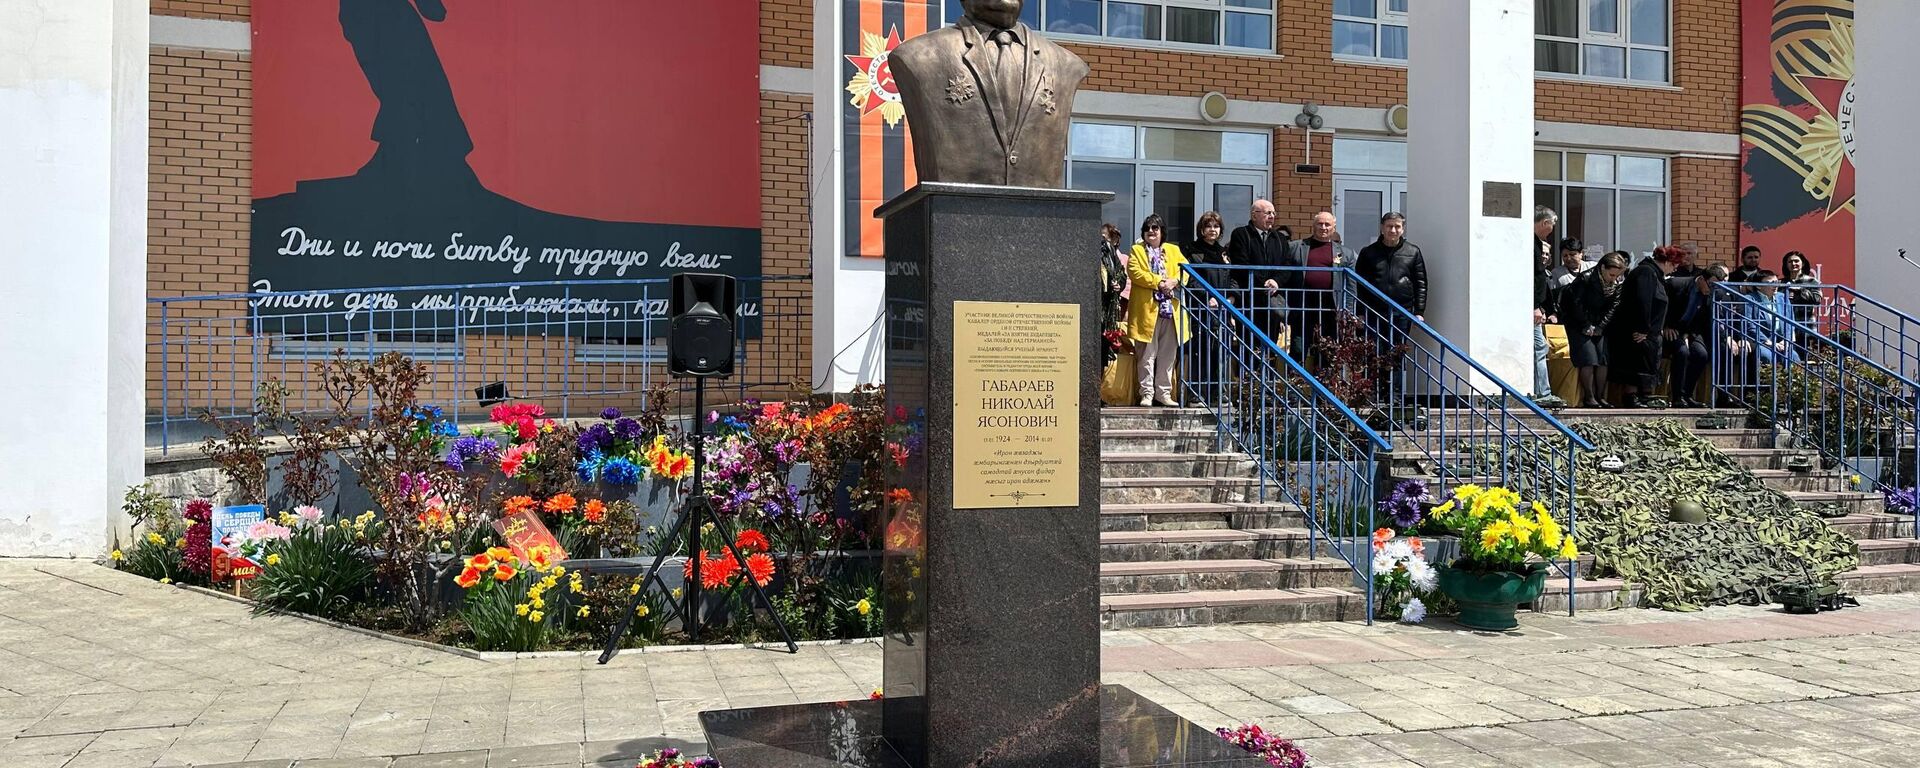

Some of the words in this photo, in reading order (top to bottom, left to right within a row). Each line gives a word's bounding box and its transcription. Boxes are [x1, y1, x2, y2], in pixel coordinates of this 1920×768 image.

[278, 227, 335, 256] Дни
[343, 240, 363, 257] и
[372, 240, 436, 259] ночи
[444, 232, 531, 274] битву
[539, 247, 648, 277] трудную
[249, 279, 334, 309] Этот
[343, 292, 399, 321] день
[411, 294, 456, 310] мы
[458, 285, 620, 324] приближали,
[981, 380, 1054, 392] ГАБАРАЕВ
[981, 394, 1054, 410] НИКОЛАЙ
[977, 415, 1058, 428] ЯСОНОВИЧ
[995, 435, 1011, 443] 1924
[1024, 435, 1040, 443] 2014
[231, 566, 256, 577] мая
